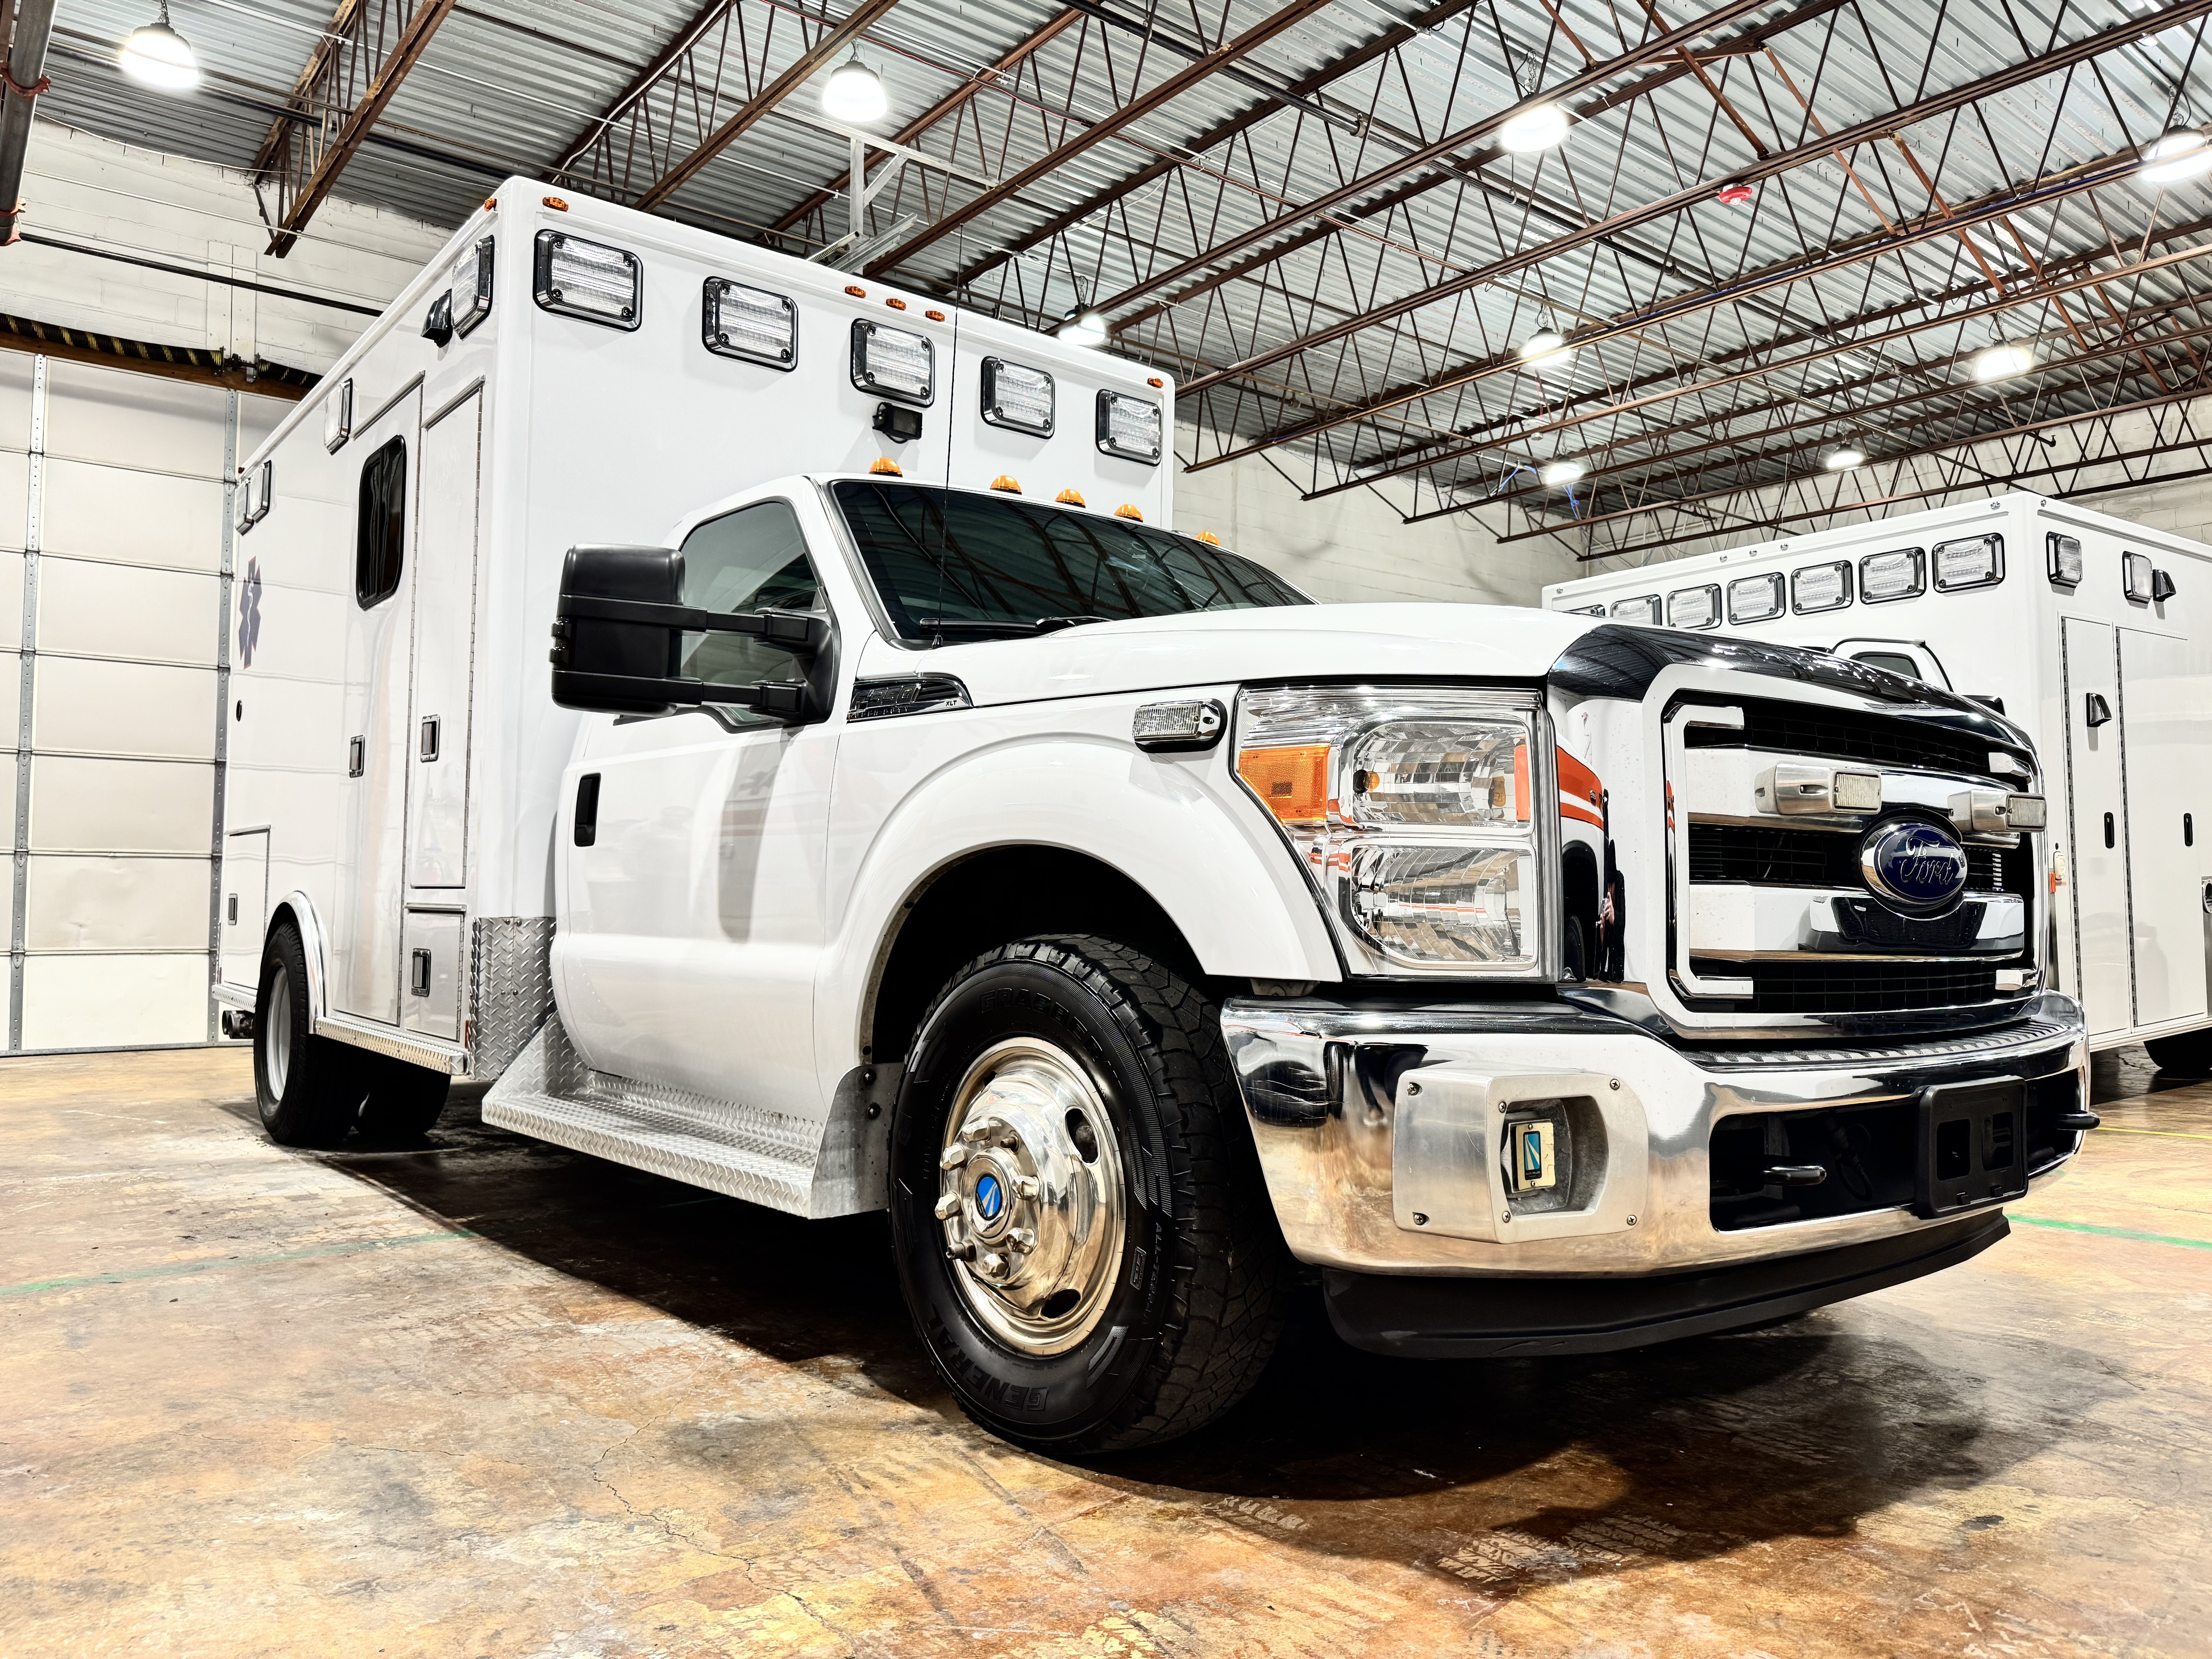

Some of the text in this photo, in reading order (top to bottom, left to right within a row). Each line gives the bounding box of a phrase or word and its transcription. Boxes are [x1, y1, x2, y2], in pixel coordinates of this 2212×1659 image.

[1900, 836, 1956, 886] Ford
[980, 988, 1104, 1063] GRABBER
[926, 1303, 1048, 1411] GENERAL
